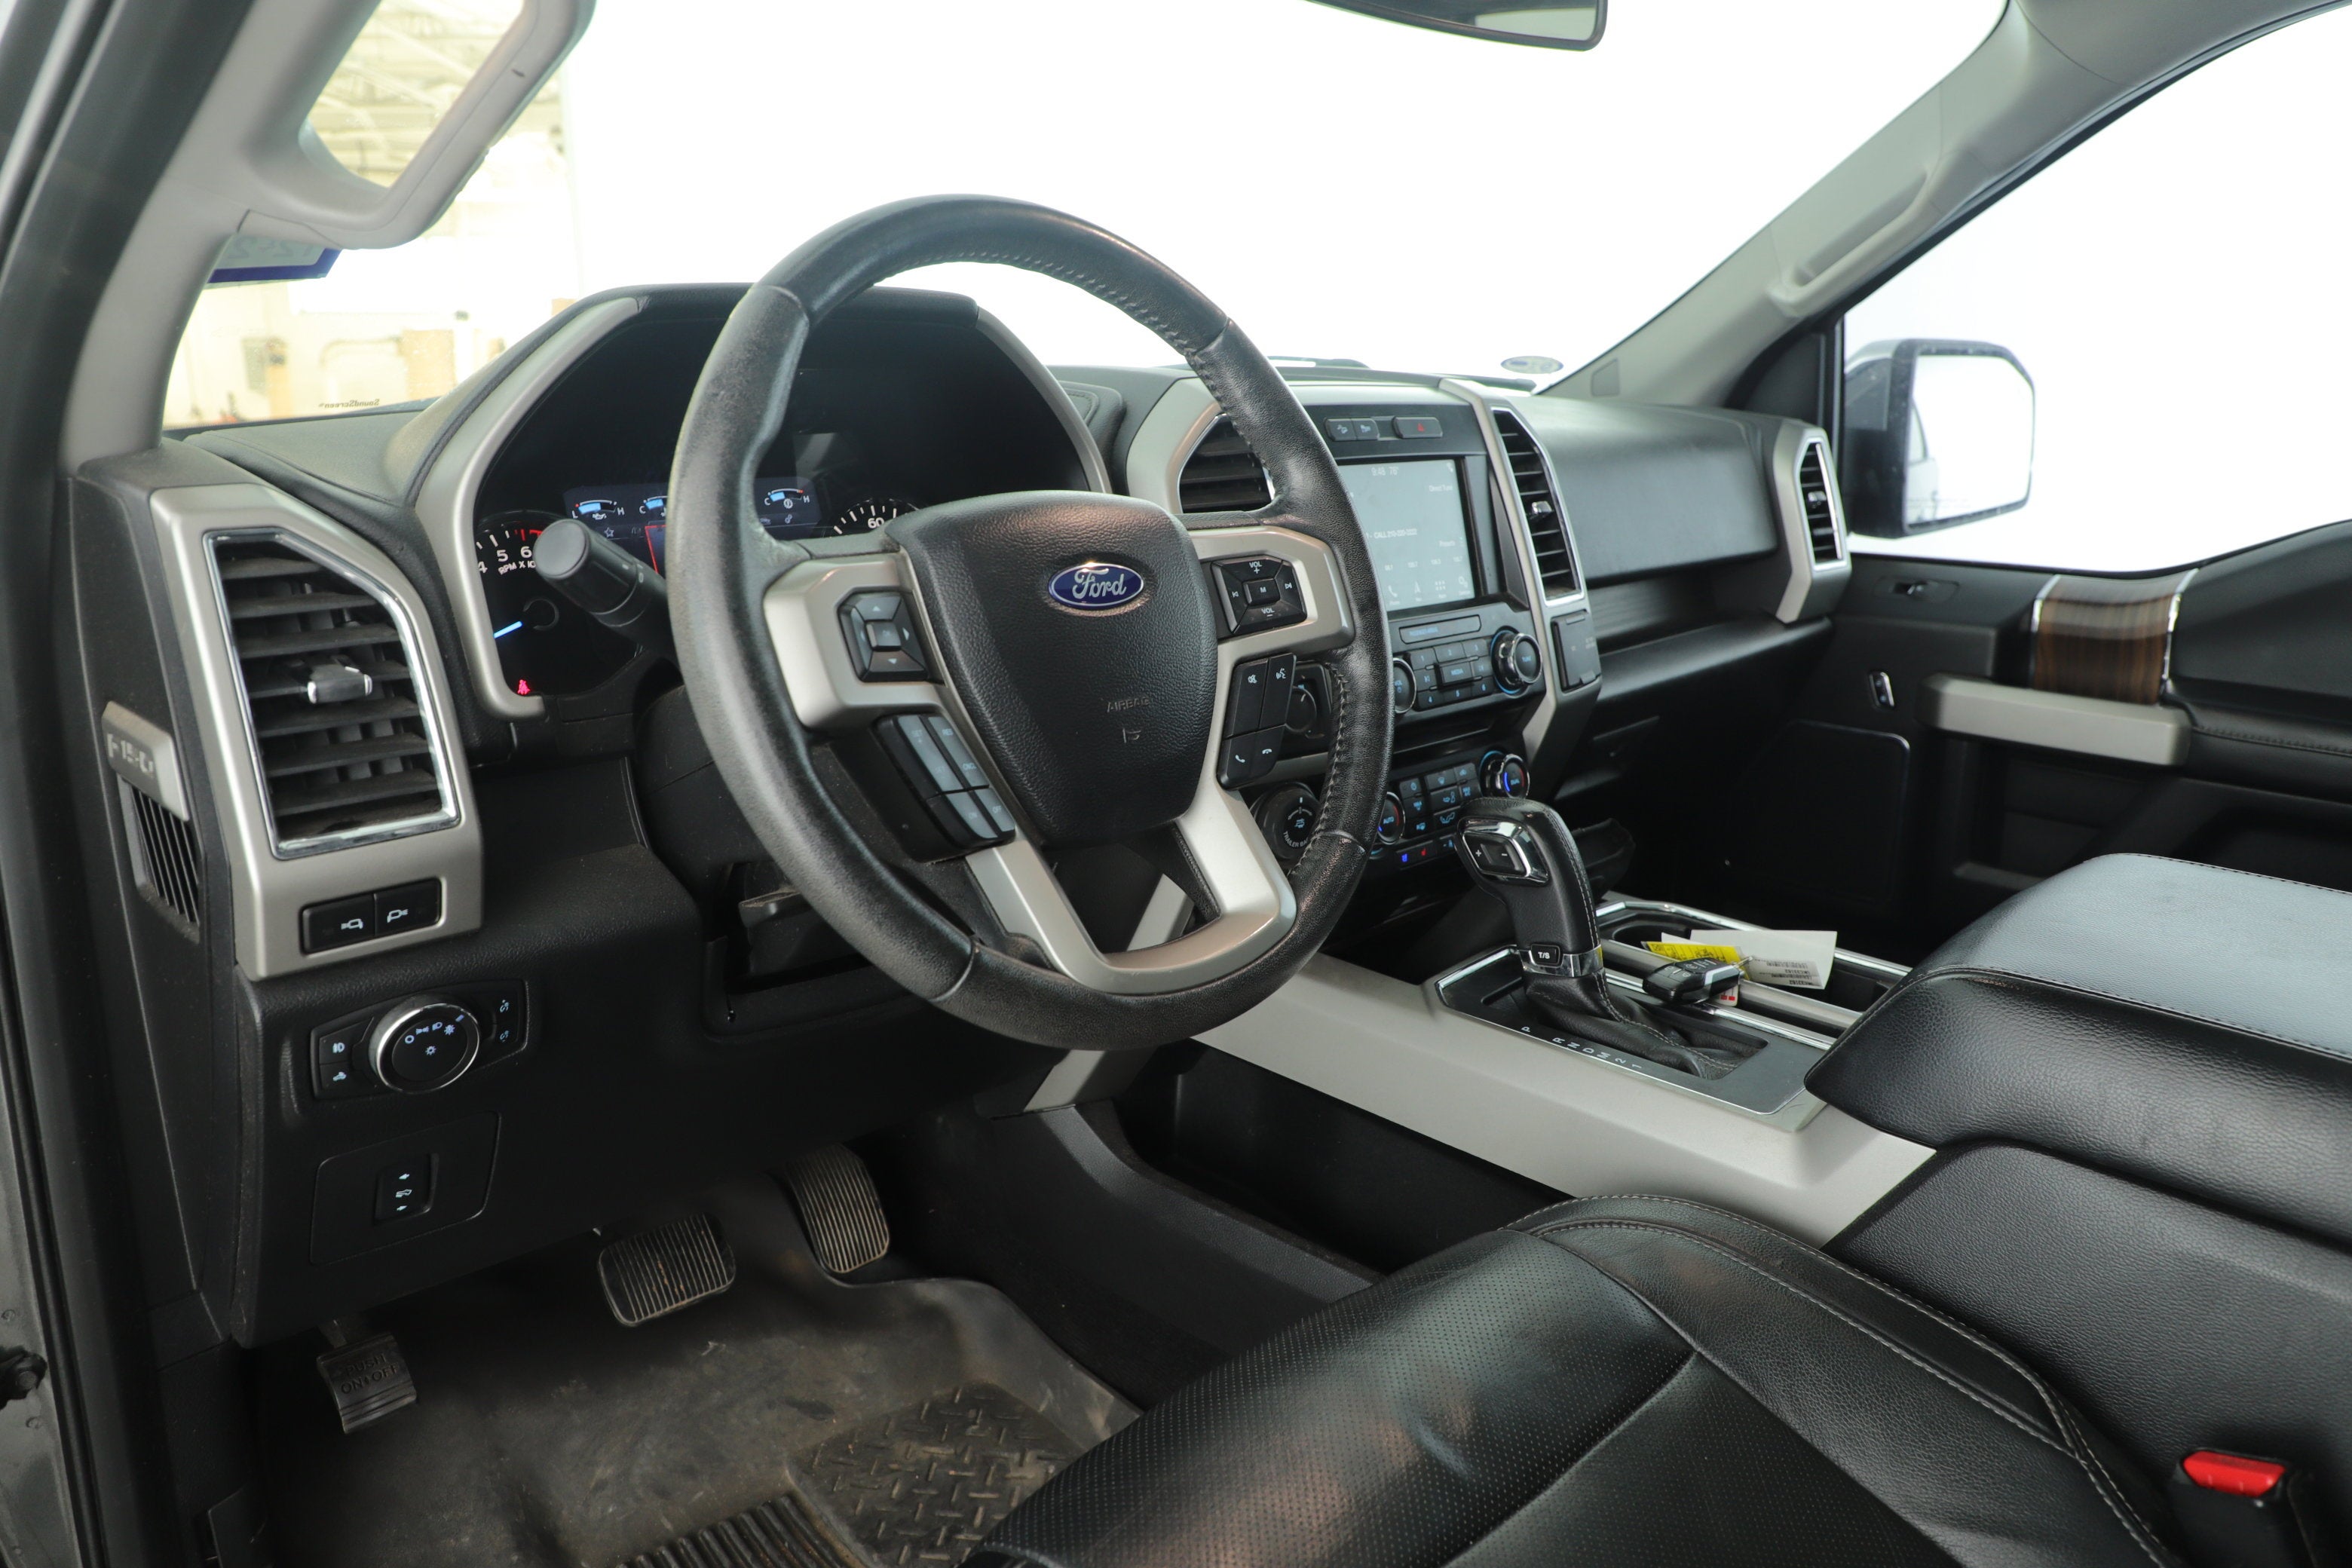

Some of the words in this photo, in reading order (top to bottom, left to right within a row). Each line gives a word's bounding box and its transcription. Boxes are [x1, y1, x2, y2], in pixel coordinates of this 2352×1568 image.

[764, 498, 770, 506] C
[571, 510, 578, 519] L
[617, 507, 625, 516] H
[639, 506, 646, 514] C
[868, 517, 884, 528] 60
[497, 550, 508, 562] 5
[520, 546, 532, 558] 6
[478, 561, 488, 574] 4
[498, 562, 517, 575] RPM
[1072, 568, 1126, 599] Ford
[1107, 696, 1150, 712] AIRBAG
[1383, 816, 1395, 825] AUTO
[1283, 831, 1299, 847] TRAILER
[1538, 951, 1550, 960] T/S
[345, 1353, 387, 1377] PUSH
